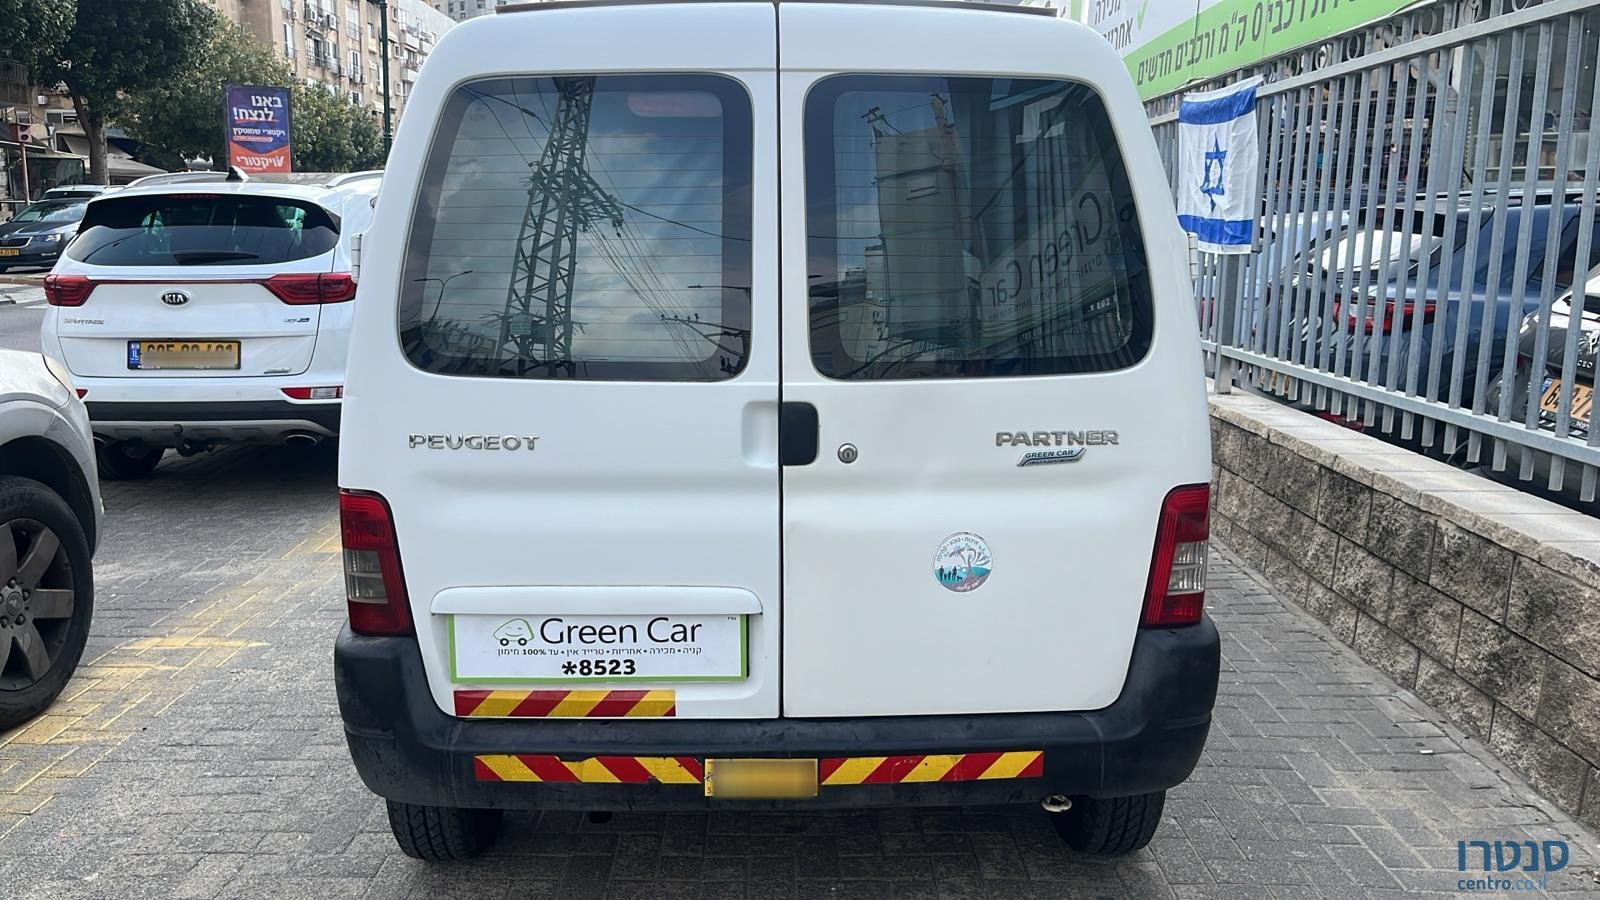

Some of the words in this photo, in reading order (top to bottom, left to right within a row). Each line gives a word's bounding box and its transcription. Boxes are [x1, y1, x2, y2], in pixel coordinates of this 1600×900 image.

[1175, 29, 1216, 71] ורכבים
[1137, 48, 1172, 86] חדשים
[251, 95, 283, 108] באנו
[232, 107, 274, 121] לנצח!
[163, 294, 186, 304] KIA
[408, 433, 540, 451] PEUGEOT
[995, 430, 1120, 447] PARTNER
[1025, 451, 1055, 459] GREEN
[540, 618, 637, 644] Green
[647, 617, 703, 643] Car
[497, 649, 520, 657] מימון
[566, 649, 579, 657] אין
[581, 648, 605, 656] טרייד
[611, 648, 642, 656] אחריות
[650, 647, 676, 655] מכירה
[682, 647, 702, 656] קניה
